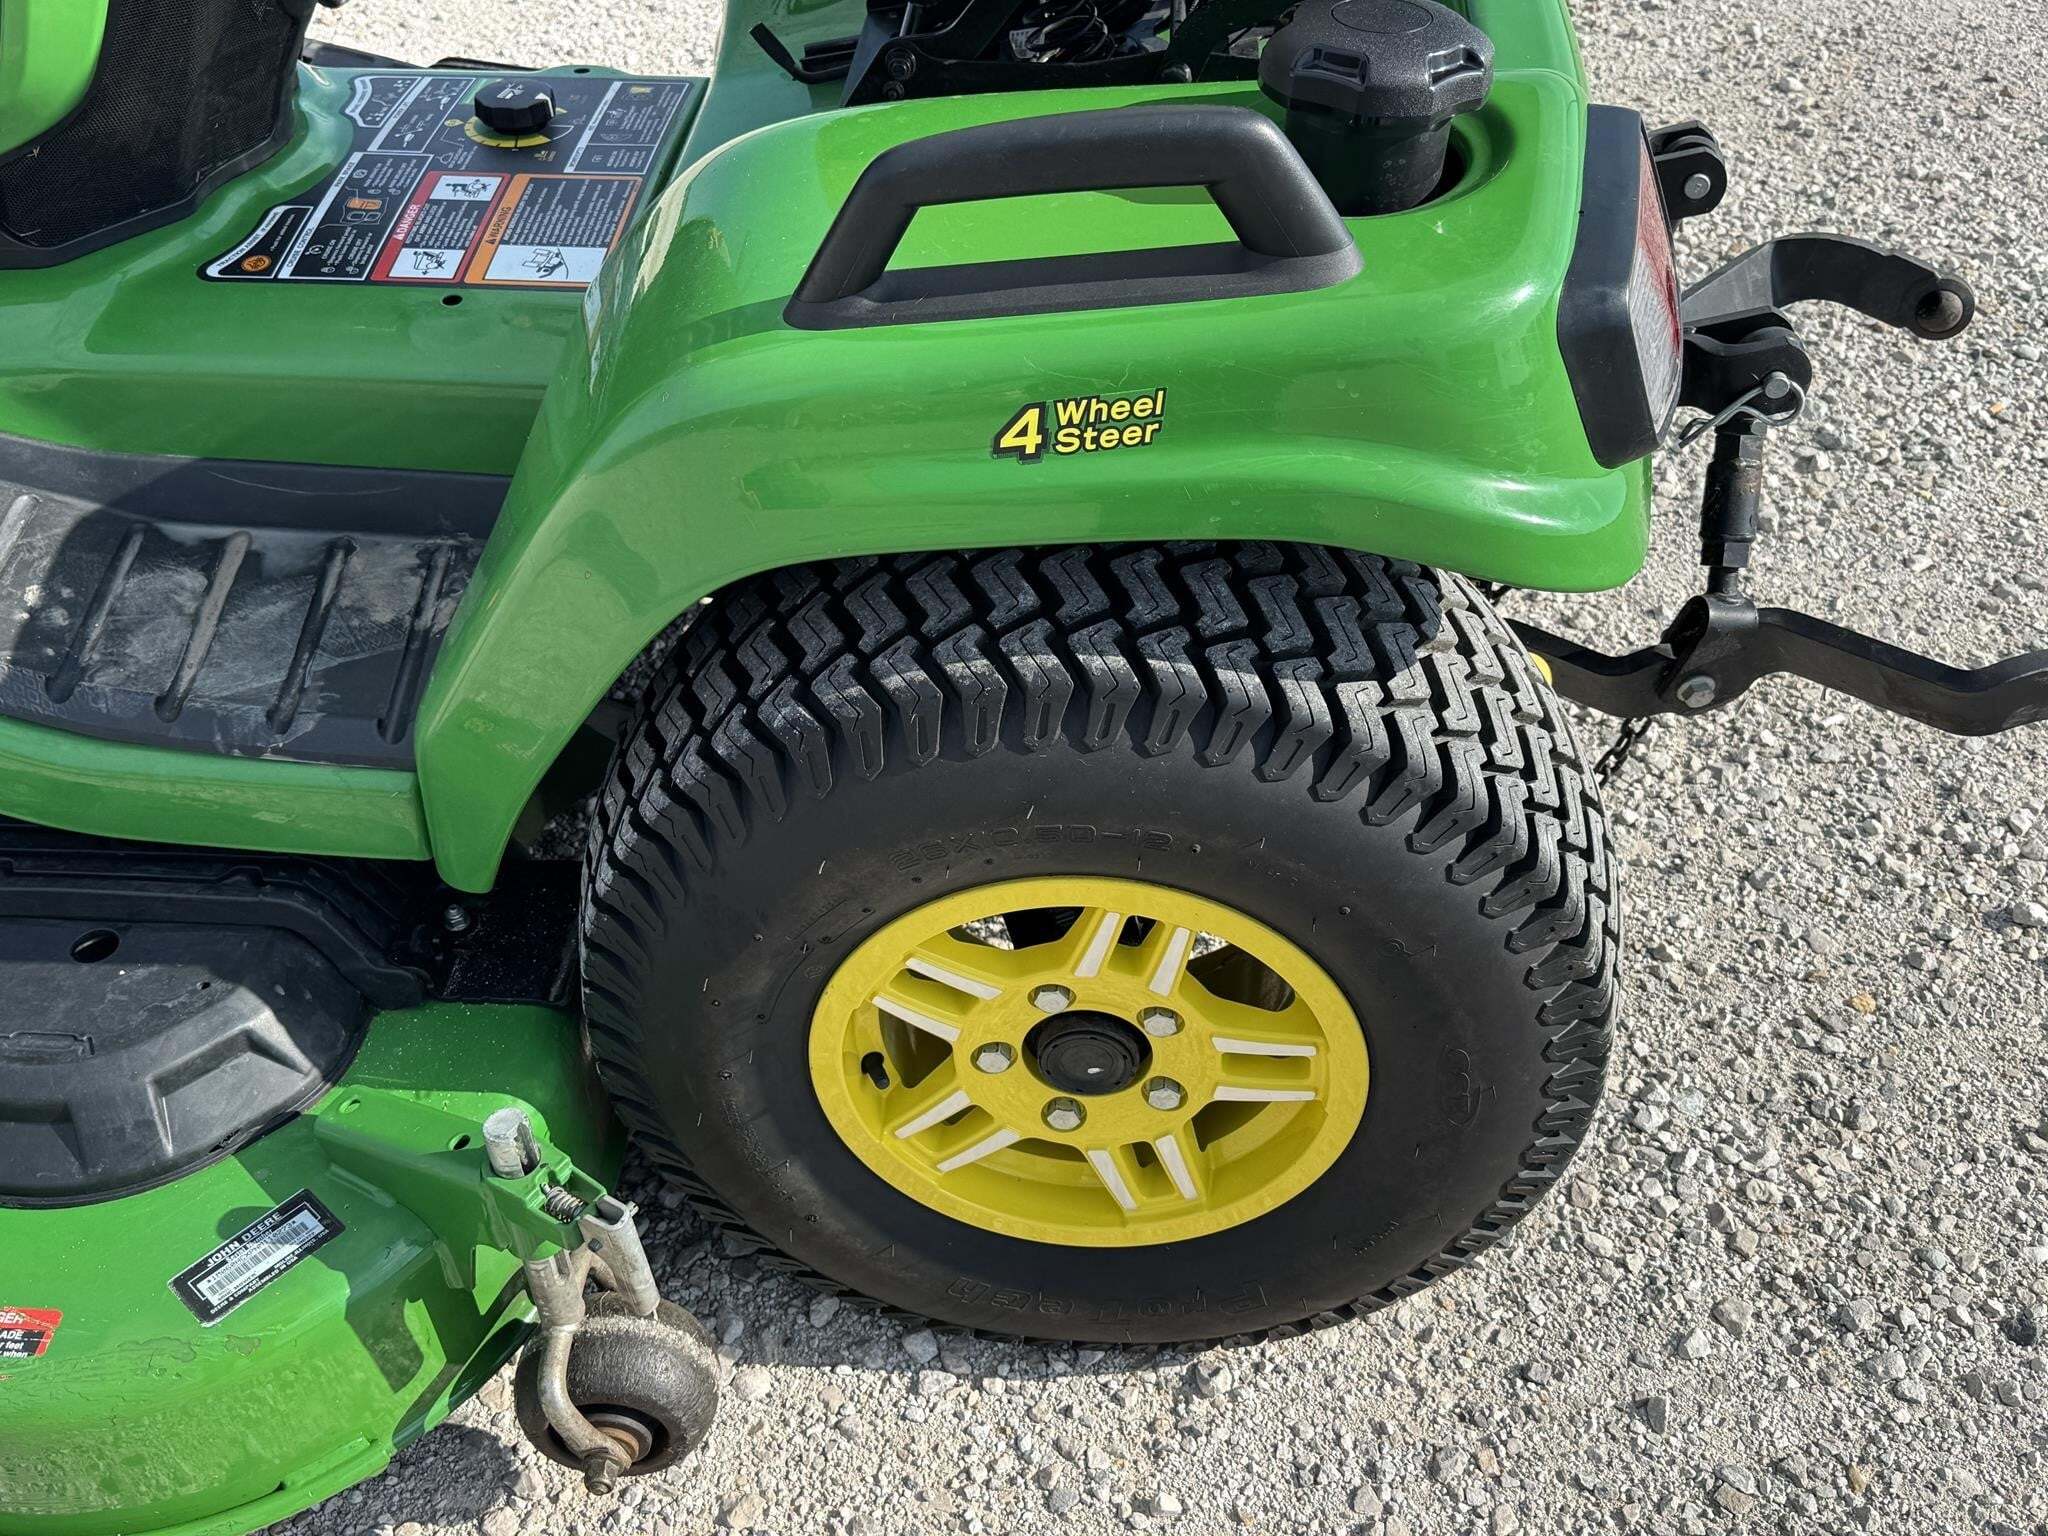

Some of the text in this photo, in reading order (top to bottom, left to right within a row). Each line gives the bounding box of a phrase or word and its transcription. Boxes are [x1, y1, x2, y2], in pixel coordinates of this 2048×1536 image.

[399, 204, 422, 234] DANGER
[488, 206, 512, 237] WARNING
[286, 227, 315, 268] CRUISE CONTROL
[997, 389, 1165, 458] 4 Wheel
[1054, 422, 1161, 455] Steer
[205, 1239, 241, 1268] JOHN
[240, 1210, 283, 1242] DEERE
[224, 1245, 247, 1263] Serial
[244, 1227, 274, 1249] Number
[3, 1349, 28, 1359] when
[5, 1340, 25, 1350] feet
